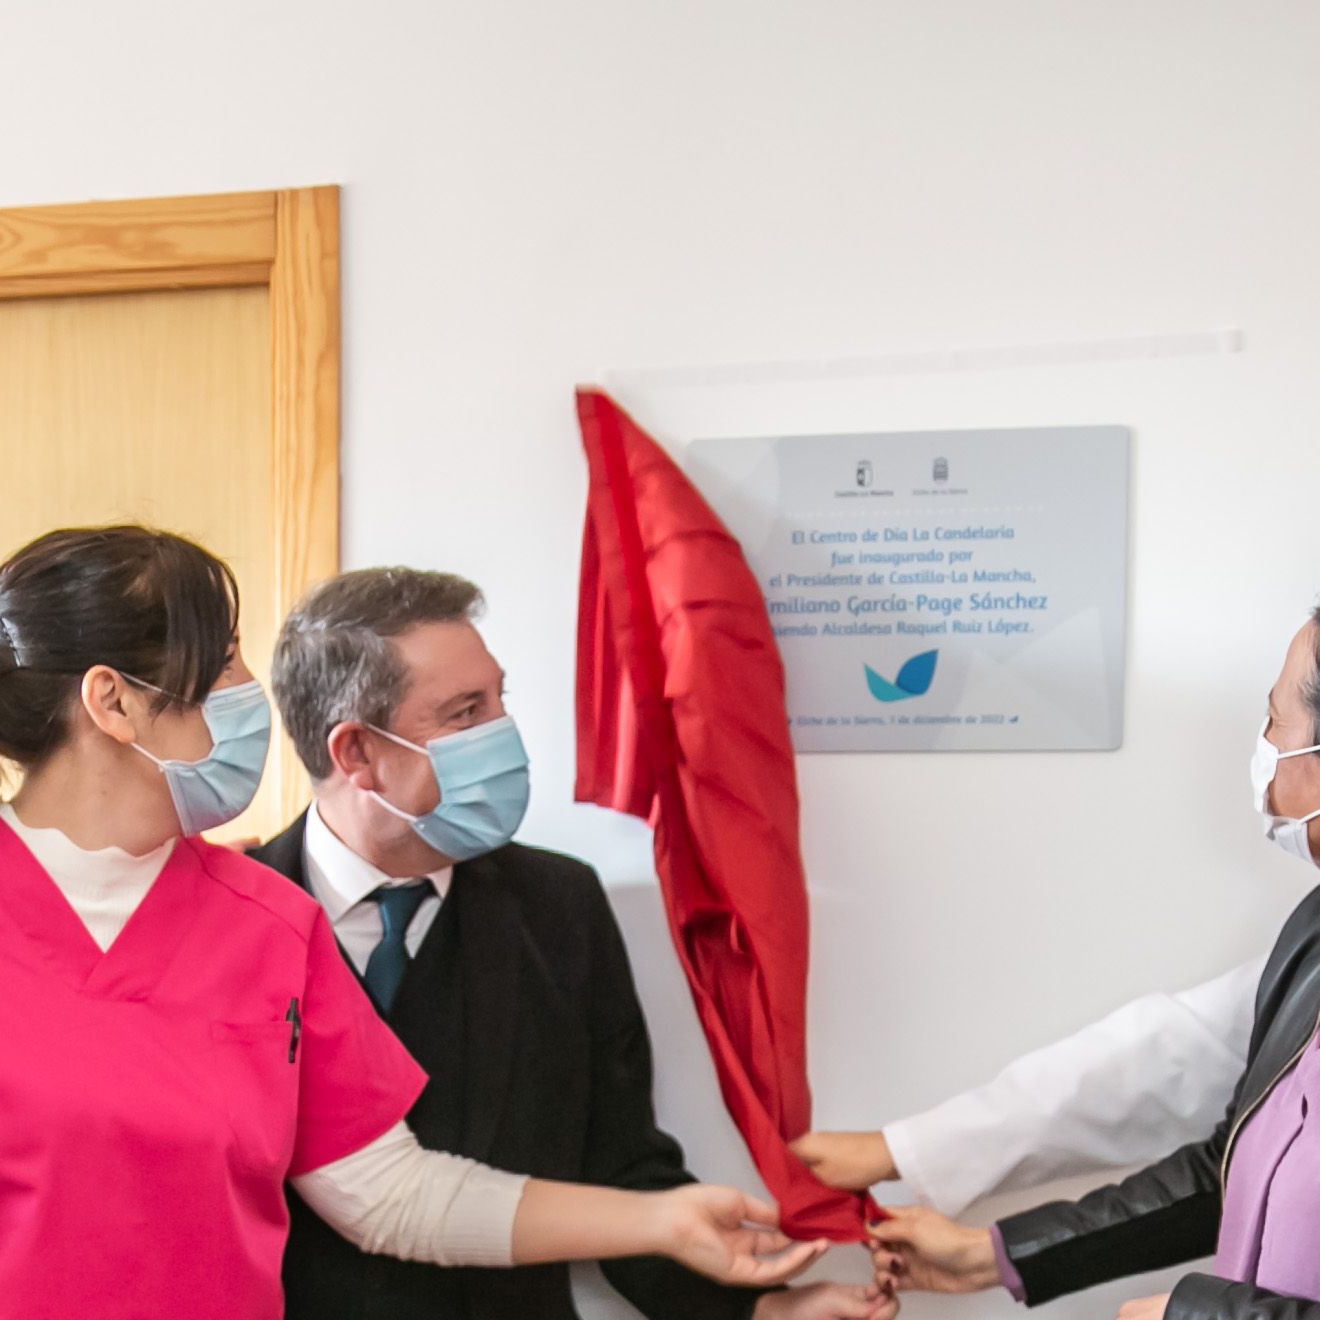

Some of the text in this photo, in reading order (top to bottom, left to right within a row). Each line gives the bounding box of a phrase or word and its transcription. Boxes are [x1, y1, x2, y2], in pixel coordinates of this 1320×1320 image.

[791, 530, 805, 545] El
[810, 529, 857, 544] Centro
[862, 528, 878, 543] de
[912, 527, 930, 541] La
[934, 525, 1015, 540] Candelaria
[830, 549, 974, 567] fue inaugurado por
[787, 573, 863, 587] Presidente
[867, 572, 885, 585] de
[847, 593, 963, 616] García-Page
[969, 591, 1048, 611] Sánchez
[823, 622, 892, 635] Alcaldesa
[896, 620, 947, 635] Raquel
[952, 619, 983, 633] Ruiz
